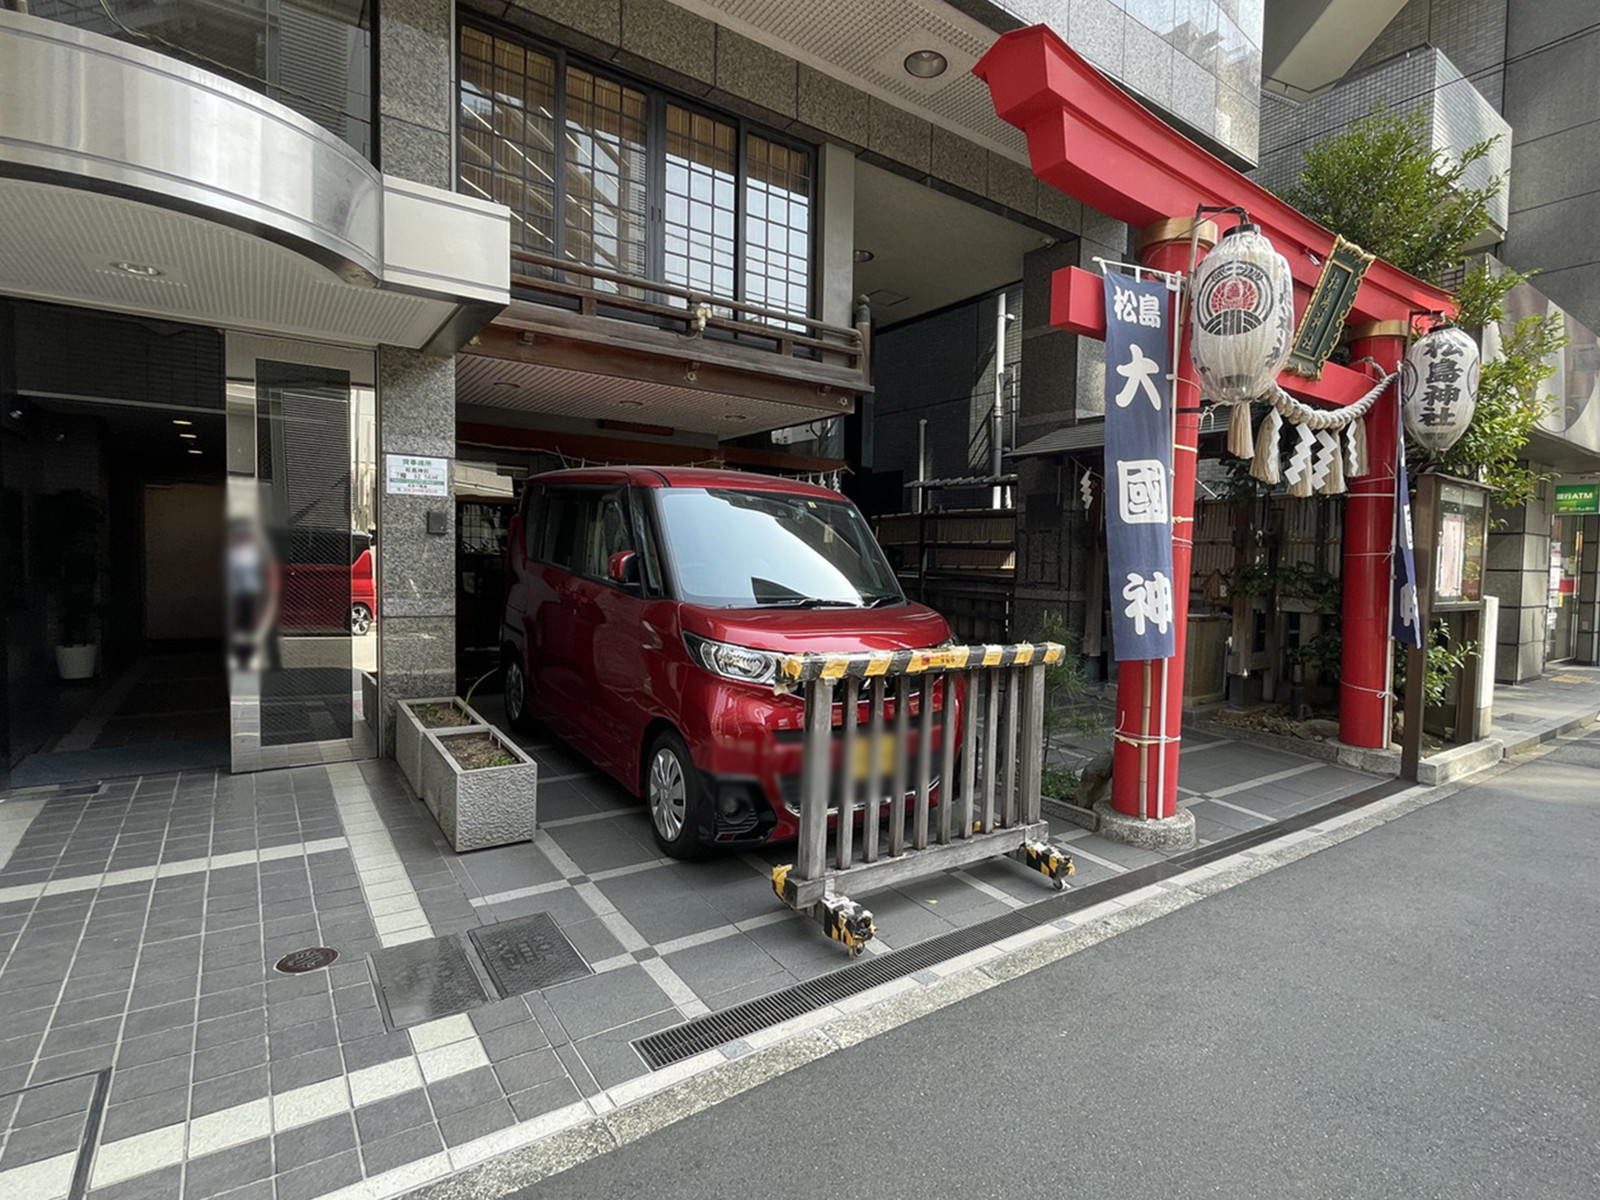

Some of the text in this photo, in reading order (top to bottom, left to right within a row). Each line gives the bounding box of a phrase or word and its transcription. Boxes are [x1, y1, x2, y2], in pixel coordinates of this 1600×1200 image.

[1113, 286, 1161, 328] 松島
[1418, 339, 1465, 427] 松島神社
[1115, 343, 1173, 636] 大國神
